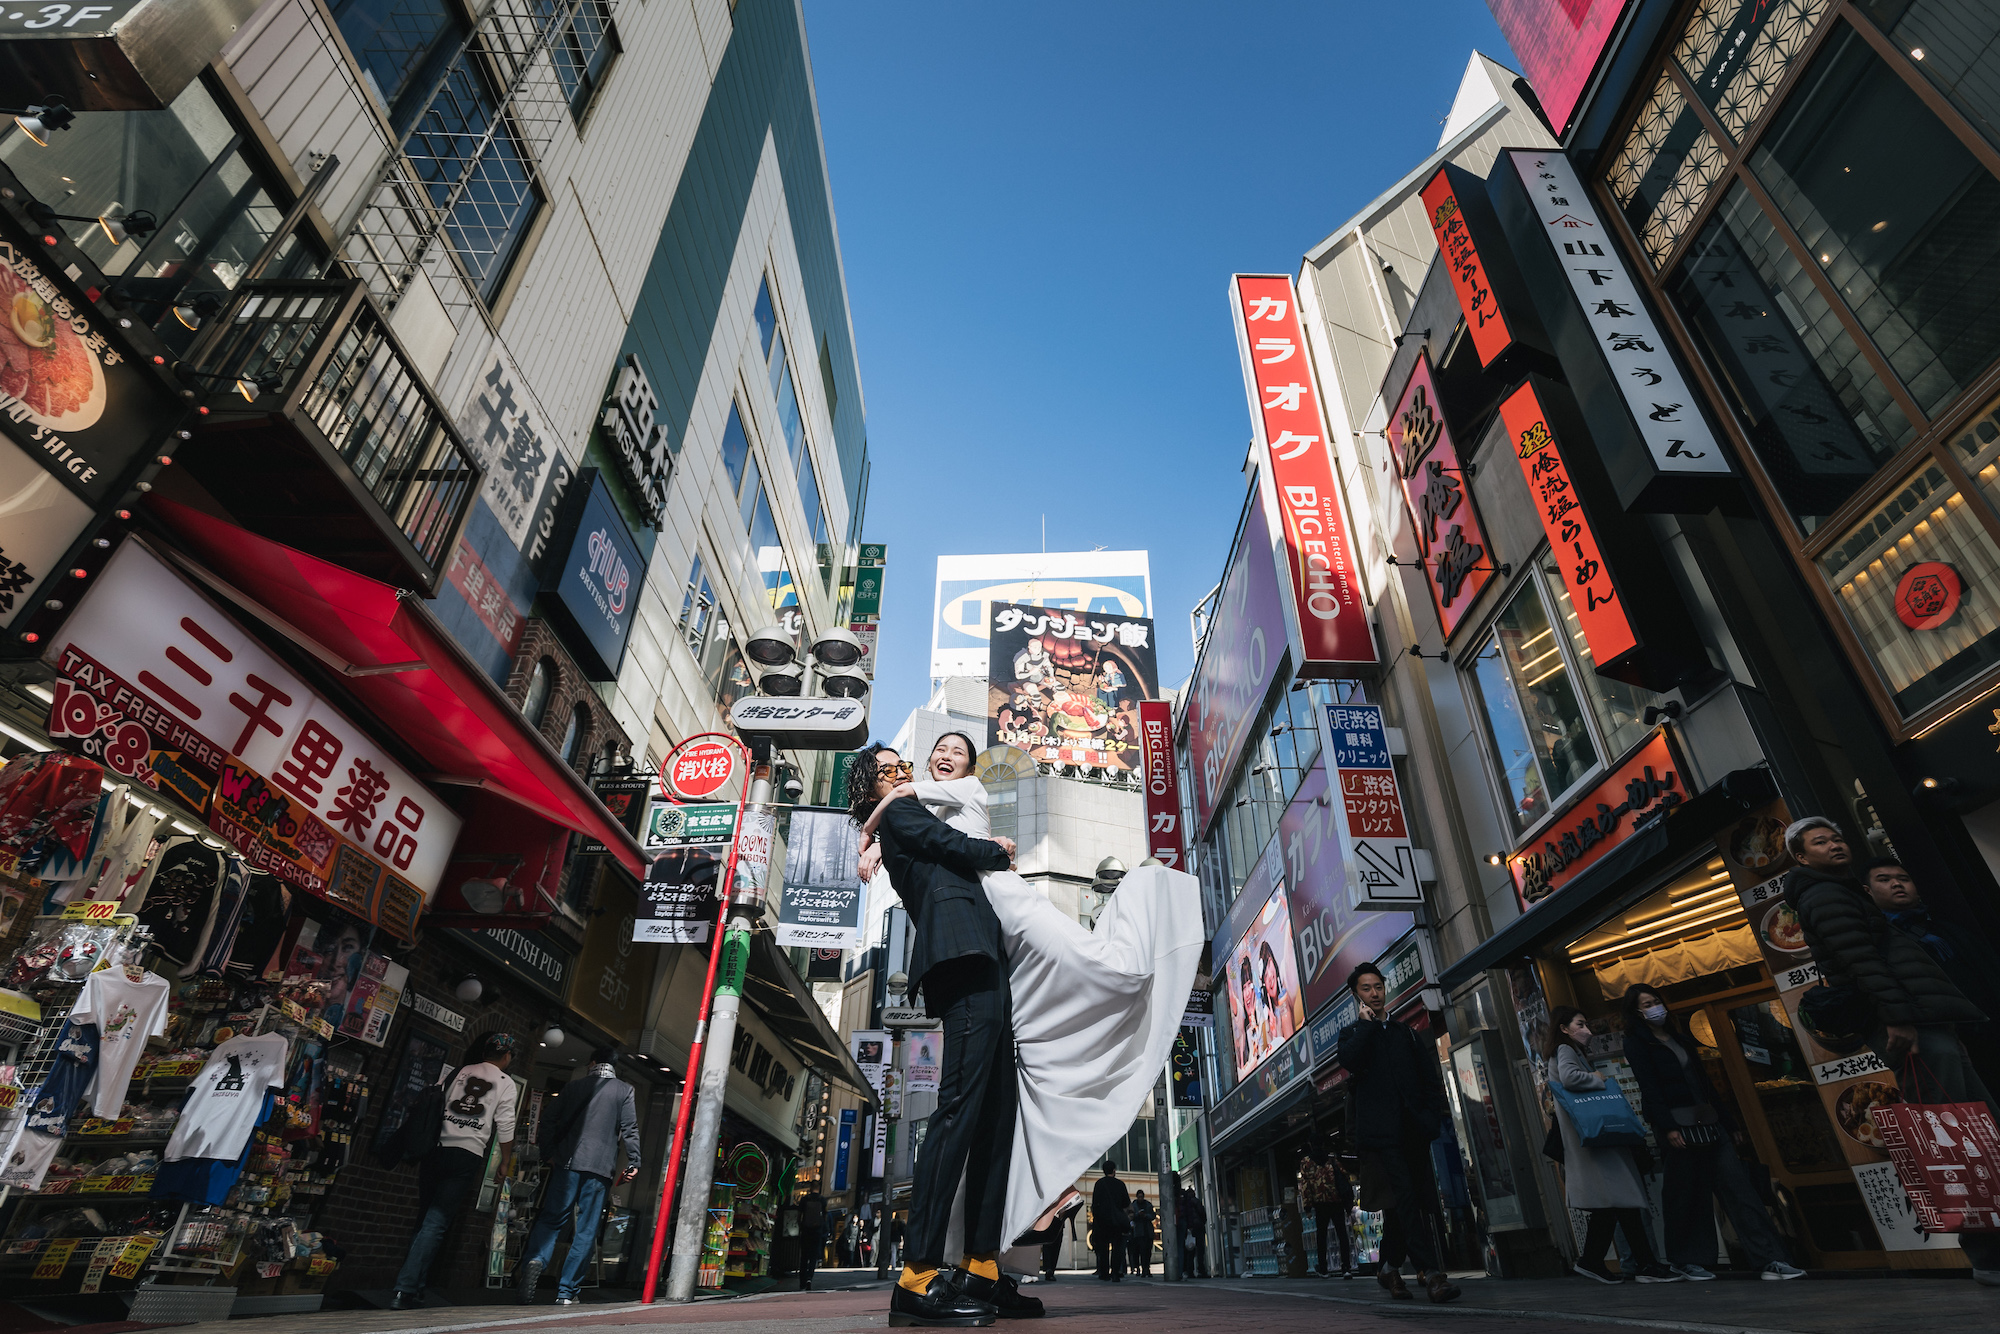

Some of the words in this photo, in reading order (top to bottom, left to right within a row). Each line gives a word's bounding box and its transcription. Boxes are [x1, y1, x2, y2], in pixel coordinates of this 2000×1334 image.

[1533, 160, 1570, 207] さぬき麺
[1433, 194, 1499, 332] 超俺流塩らーめん
[1563, 240, 1706, 460] 山下本気うどん
[1248, 296, 1320, 462] カラオケ
[478, 358, 548, 503] 牛繁
[620, 352, 681, 504] 西村
[31, 424, 98, 484] SHIGE
[609, 408, 666, 526] NISHIMURA
[489, 476, 525, 530] SHIGE
[1519, 421, 1615, 613] 超俺流塩らーめん
[1284, 485, 1323, 536] BIG
[1304, 540, 1341, 621] ECHO
[1321, 496, 1337, 534] Karaoke
[1330, 535, 1353, 607] Entertainment
[588, 528, 630, 615] HUB
[579, 565, 609, 614] BRITISH
[606, 606, 622, 637] PUB
[994, 607, 1150, 650] ダンジョン飯
[63, 650, 114, 697] TAX
[112, 686, 172, 736] FREE
[170, 725, 223, 772] HERE
[737, 706, 857, 720] 渋谷センター街
[1349, 709, 1380, 731] 渋谷
[82, 738, 103, 756] or
[138, 616, 425, 872] 三千里薬品
[995, 729, 1140, 752] 1月4日(木)より連続2クー
[1144, 720, 1163, 750] BIG
[1345, 732, 1374, 747] 眼科
[684, 750, 699, 758] FIRE
[698, 747, 725, 757] HYDRANT
[1337, 749, 1388, 765] クリニック
[677, 757, 728, 782] 消火栓
[1150, 752, 1168, 796] ECHO
[1362, 775, 1395, 797] 渋谷
[686, 814, 734, 827] 宝石広場
[1346, 799, 1400, 815] コンタクト
[1361, 817, 1394, 833] レンズ
[218, 815, 247, 847] TAX
[245, 837, 282, 871] FREE
[284, 862, 322, 891] SHOP
[643, 882, 714, 893] テイラー・スウィフト
[1359, 870, 1381, 883] 入口
[785, 887, 857, 900] テイラー・スウィフト
[790, 897, 850, 908] ようこそ日本へ!
[86, 903, 115, 919] 700
[1299, 906, 1334, 985] BIG
[538, 951, 564, 982] PUB
[442, 1009, 464, 1032] LANE
[885, 1012, 927, 1020] 渋谷センター
[1574, 1095, 1601, 1105] GELATO
[1601, 1092, 1624, 1102] PIQUE
